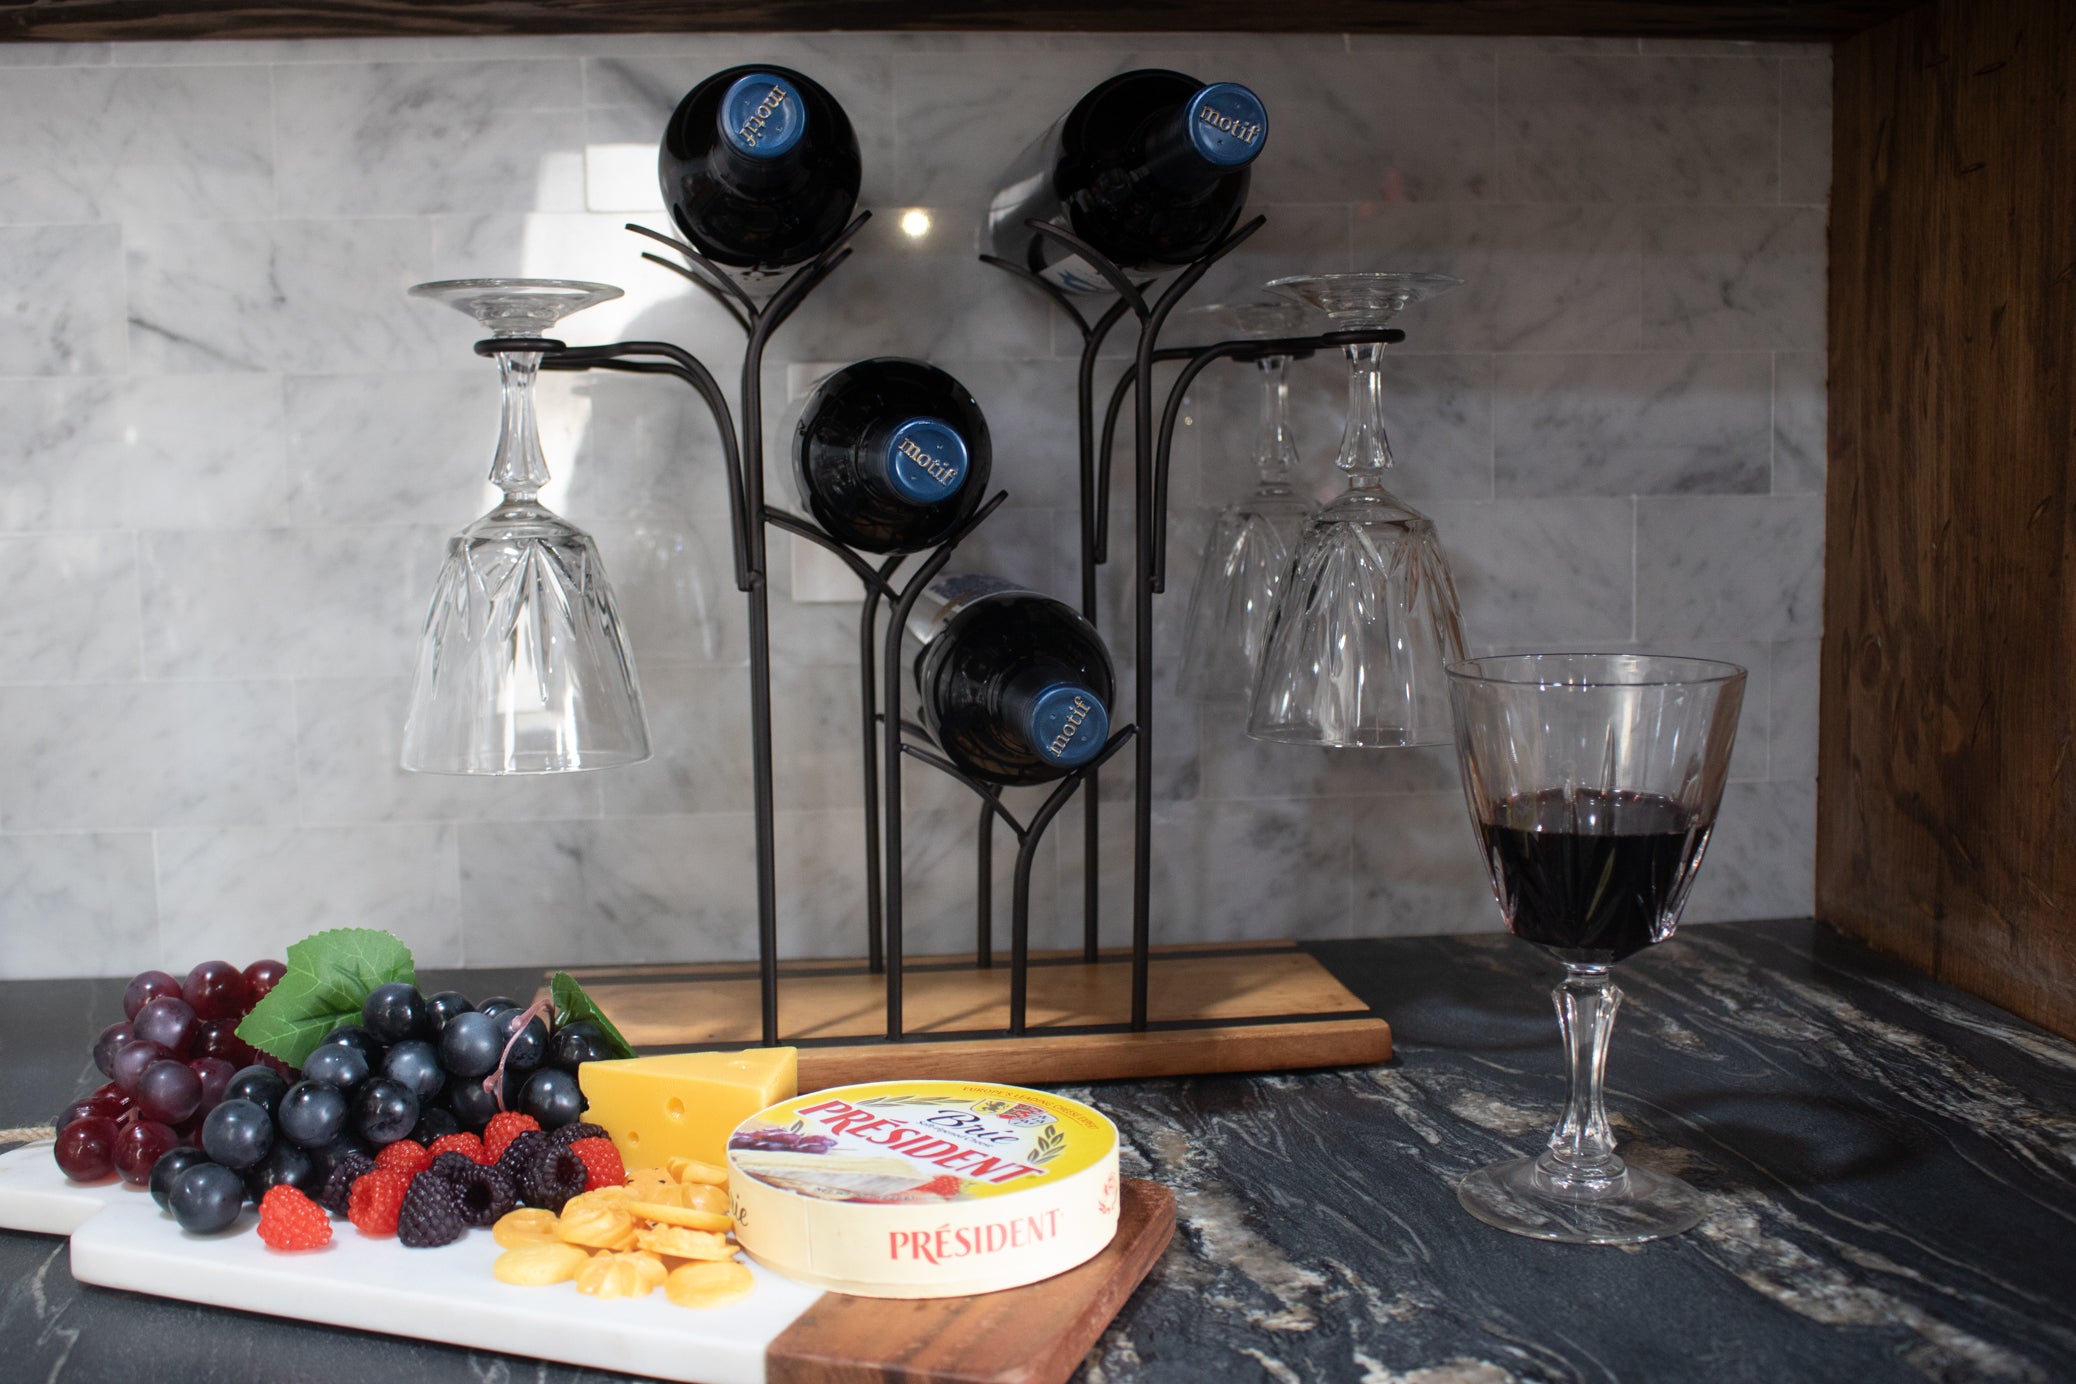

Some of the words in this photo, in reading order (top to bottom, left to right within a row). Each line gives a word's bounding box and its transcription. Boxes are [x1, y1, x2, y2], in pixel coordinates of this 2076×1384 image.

[738, 84, 787, 148] motif
[1199, 105, 1262, 145] motif
[897, 437, 959, 487] motif
[1048, 695, 1092, 758] motif
[796, 1099, 1046, 1185] PRÉSIDENT
[926, 1109, 1021, 1145] Brie
[888, 1207, 1062, 1266] PRÉSIDENT
